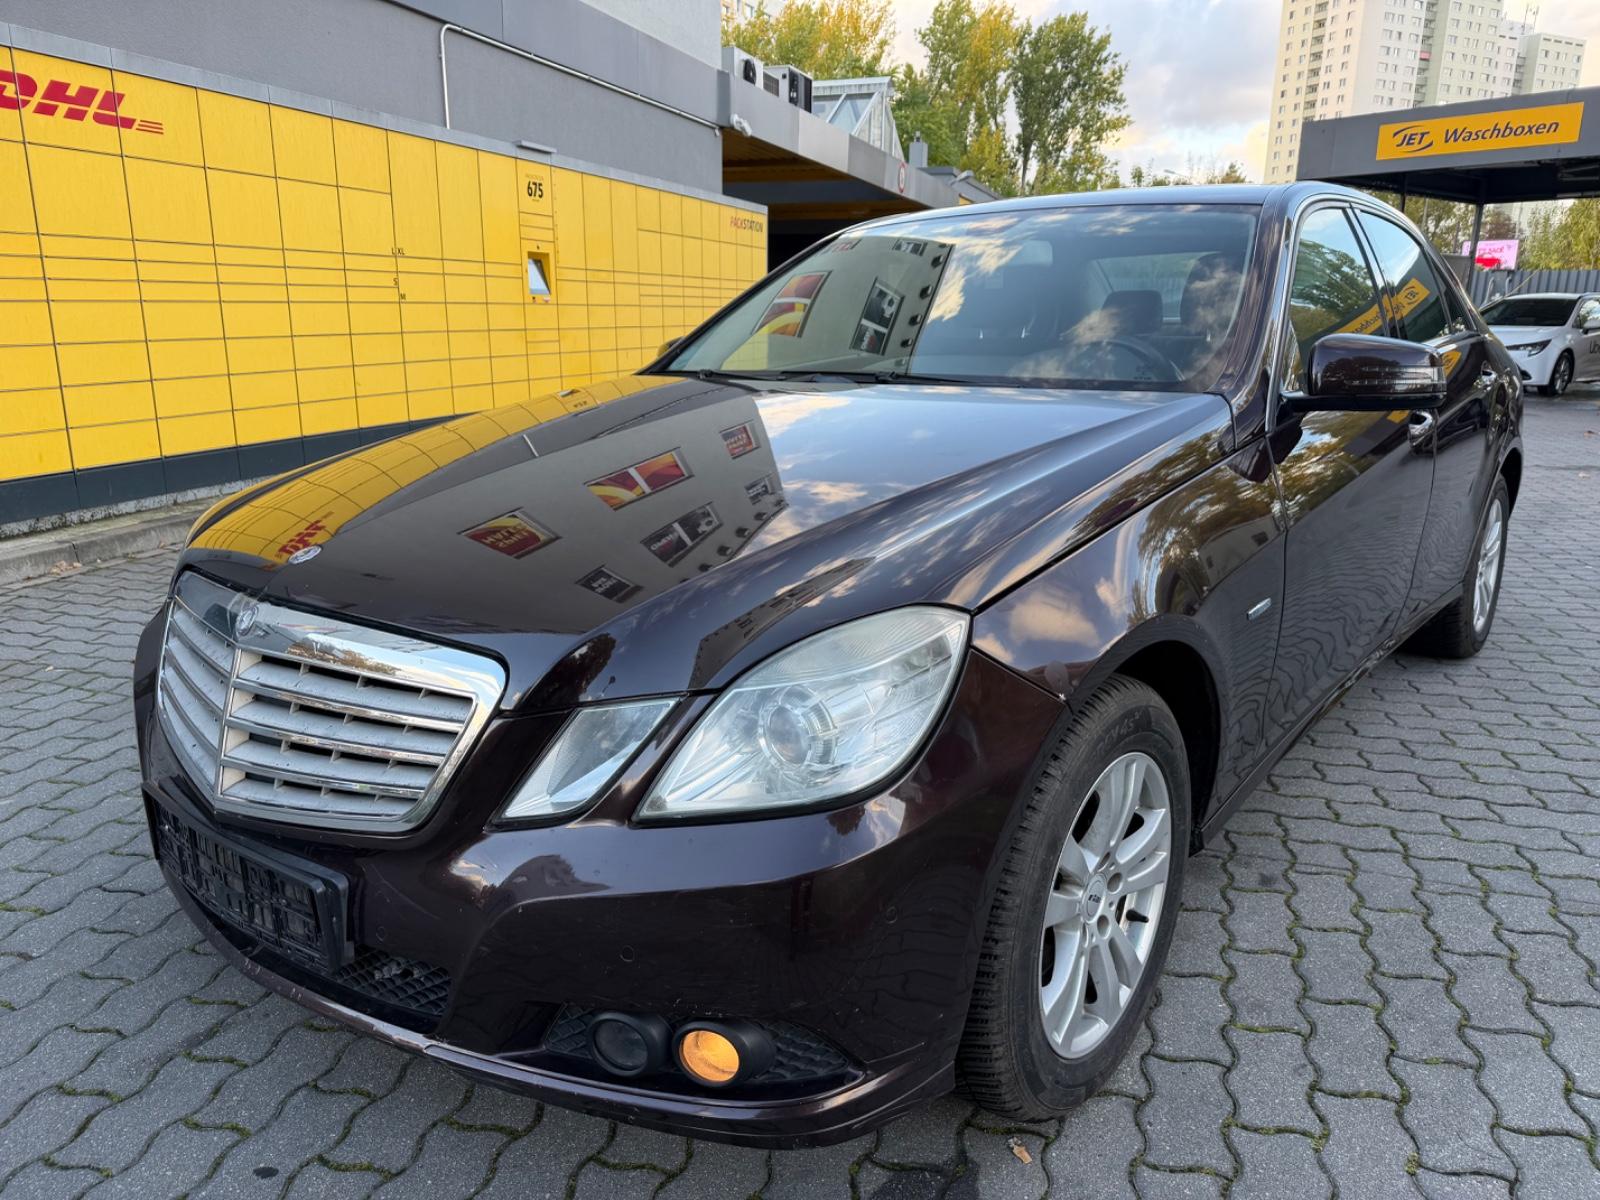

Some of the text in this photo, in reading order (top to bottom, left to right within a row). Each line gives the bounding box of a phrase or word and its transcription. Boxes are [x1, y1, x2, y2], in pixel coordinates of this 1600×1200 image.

[0, 69, 137, 130] DHL
[1395, 120, 1560, 147] JET Waschboxen
[527, 180, 544, 199] 675
